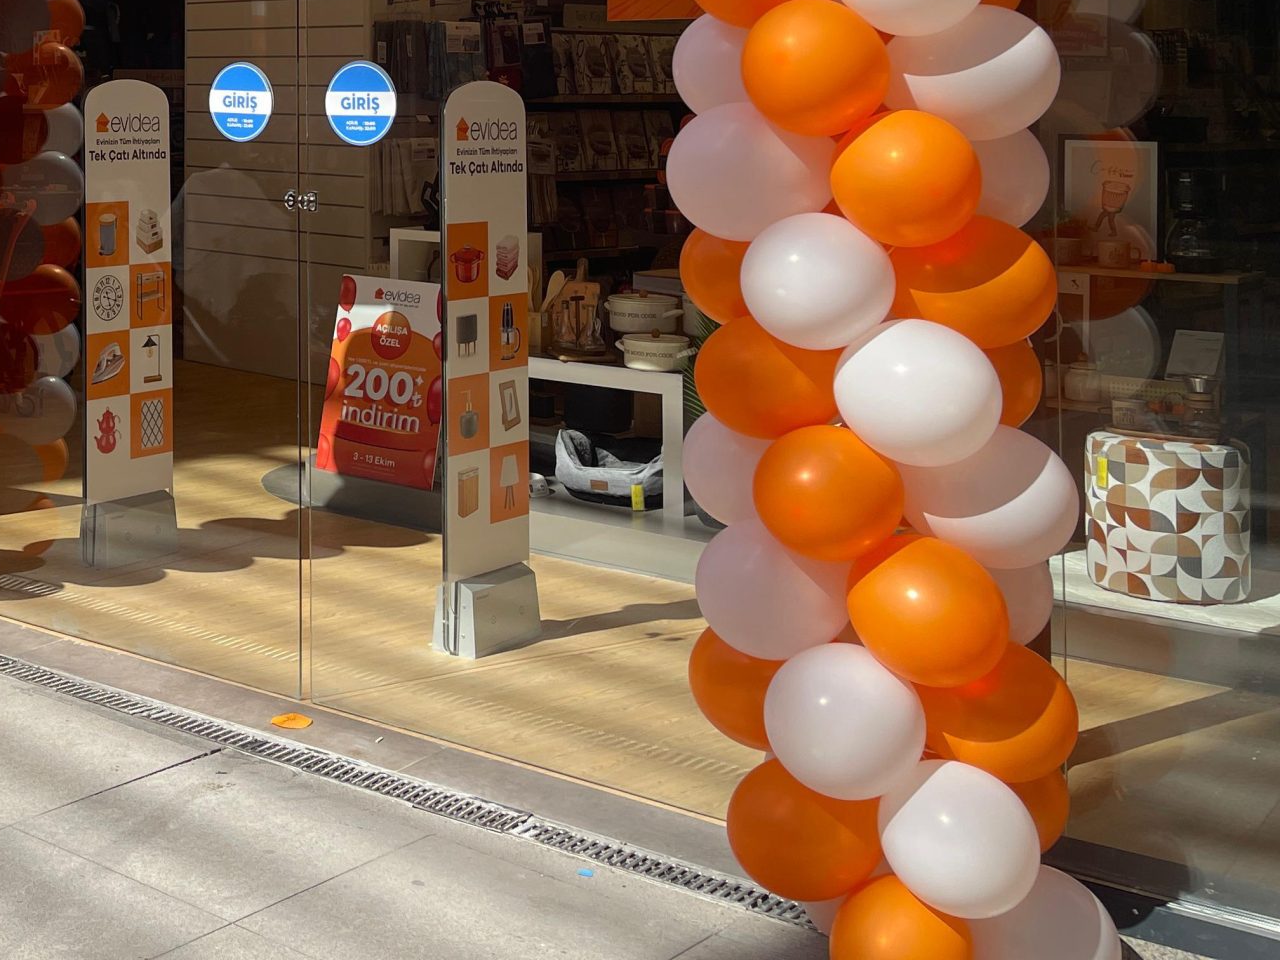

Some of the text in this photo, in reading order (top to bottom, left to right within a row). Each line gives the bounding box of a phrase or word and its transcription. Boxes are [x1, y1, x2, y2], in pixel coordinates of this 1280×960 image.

[222, 92, 257, 112] GİRİŞ
[341, 93, 380, 114] GİRİŞ
[110, 113, 160, 133] evidea
[470, 118, 517, 140] evidea
[89, 148, 167, 163] Tek Çatı Altında
[449, 160, 524, 176] Tek Çatı Altında
[384, 290, 421, 304] evidea
[375, 323, 408, 336] AÇILIŞA
[379, 335, 401, 347] ÖZEL
[344, 363, 414, 405] 200
[341, 399, 420, 433] indirim
[365, 454, 373, 464] 13
[374, 456, 396, 468] Ekim
